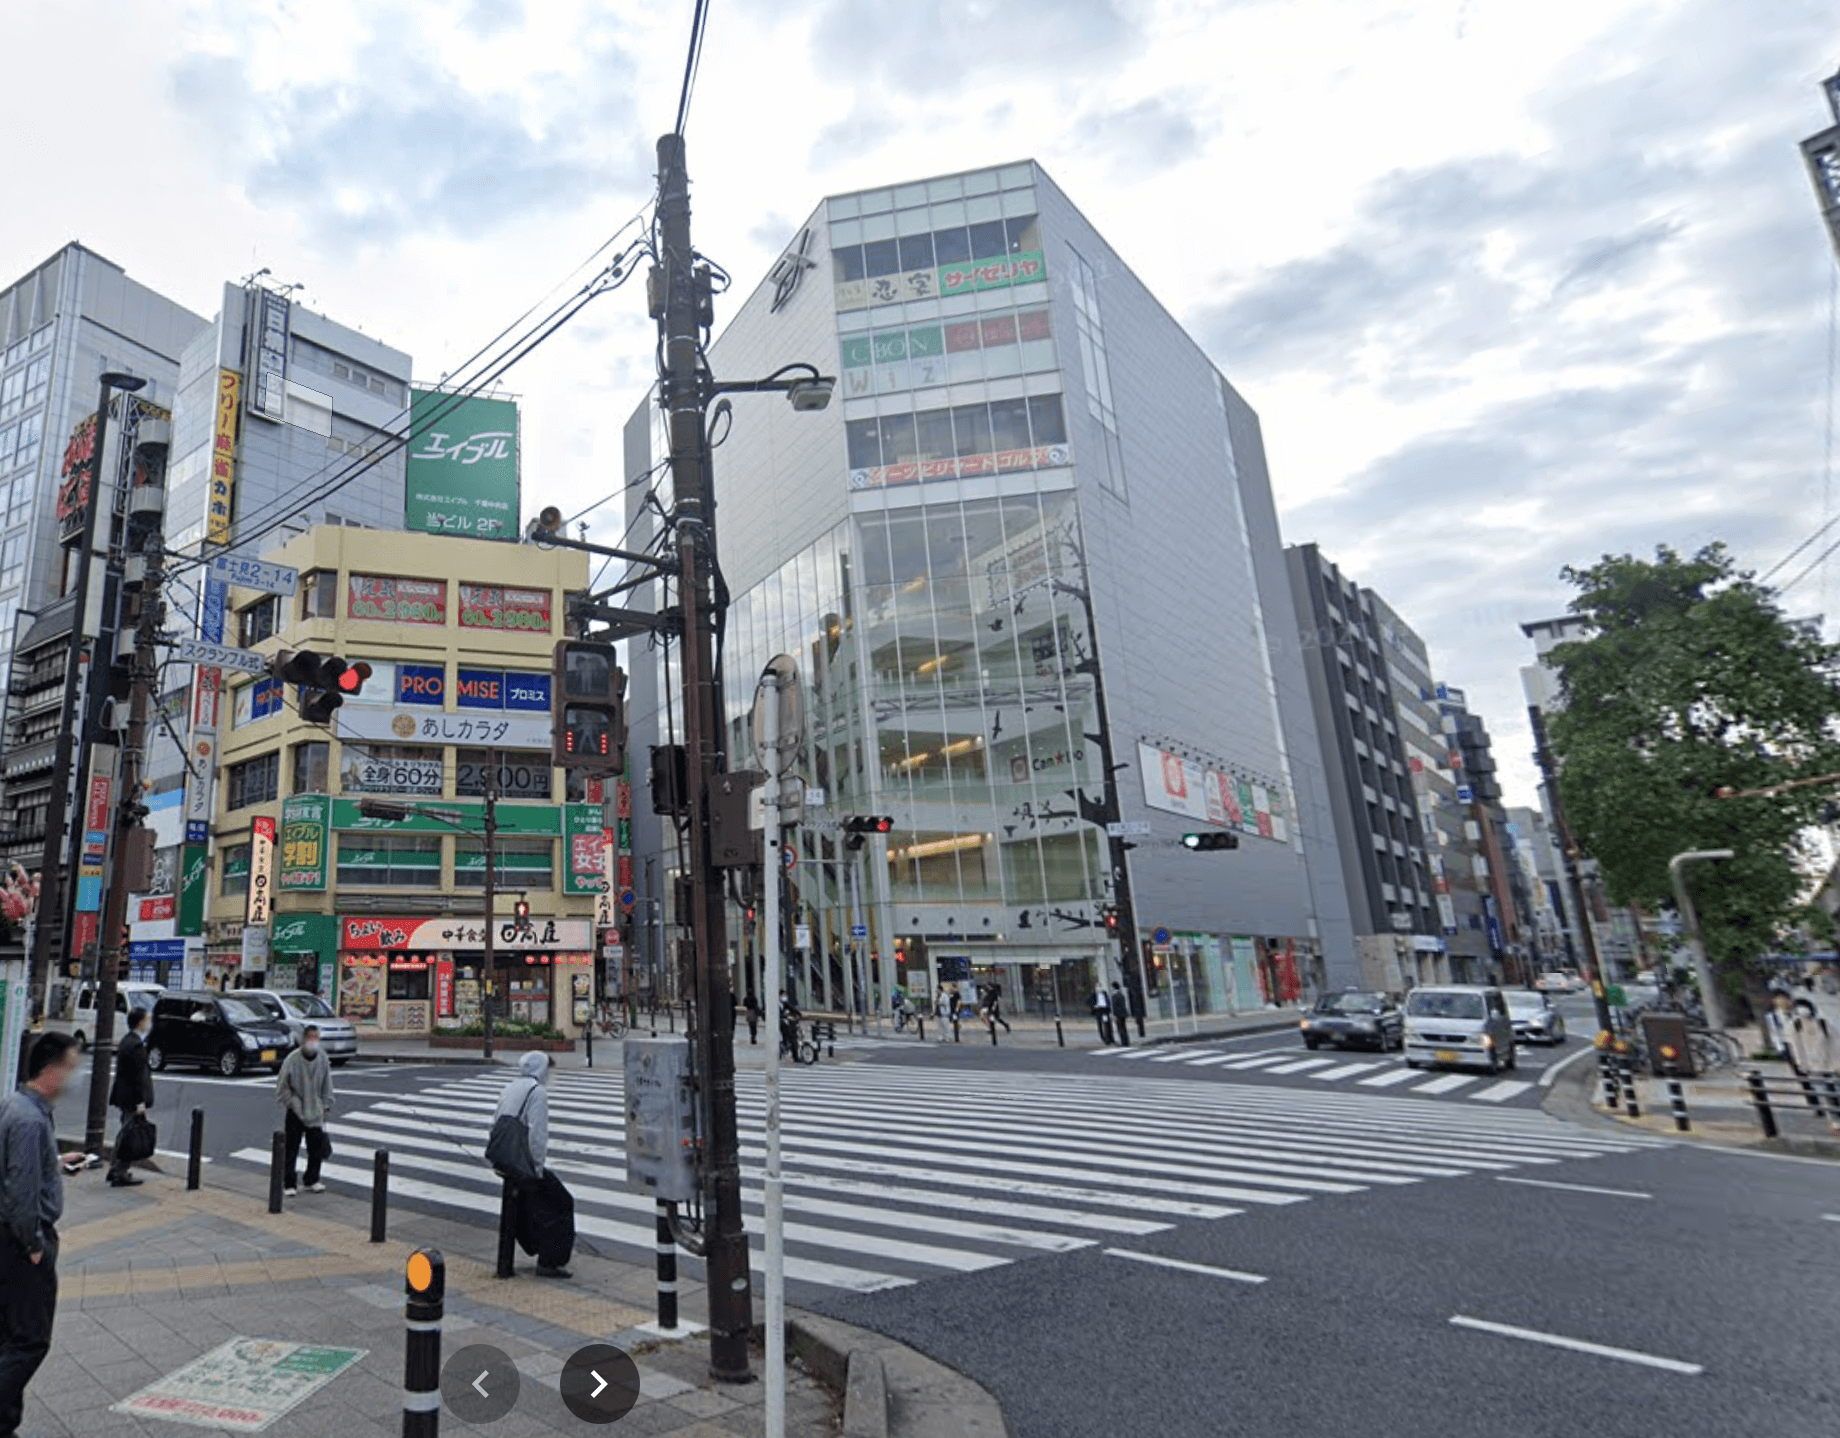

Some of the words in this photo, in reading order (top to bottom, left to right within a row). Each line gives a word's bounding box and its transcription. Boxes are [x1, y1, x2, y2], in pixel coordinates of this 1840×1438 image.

[945, 259, 1039, 288] サイゼリヤ
[411, 431, 514, 464] エイブル
[216, 557, 293, 585] 富士見2-14
[509, 687, 545, 701] プロミス
[422, 717, 509, 741] あしカラダ
